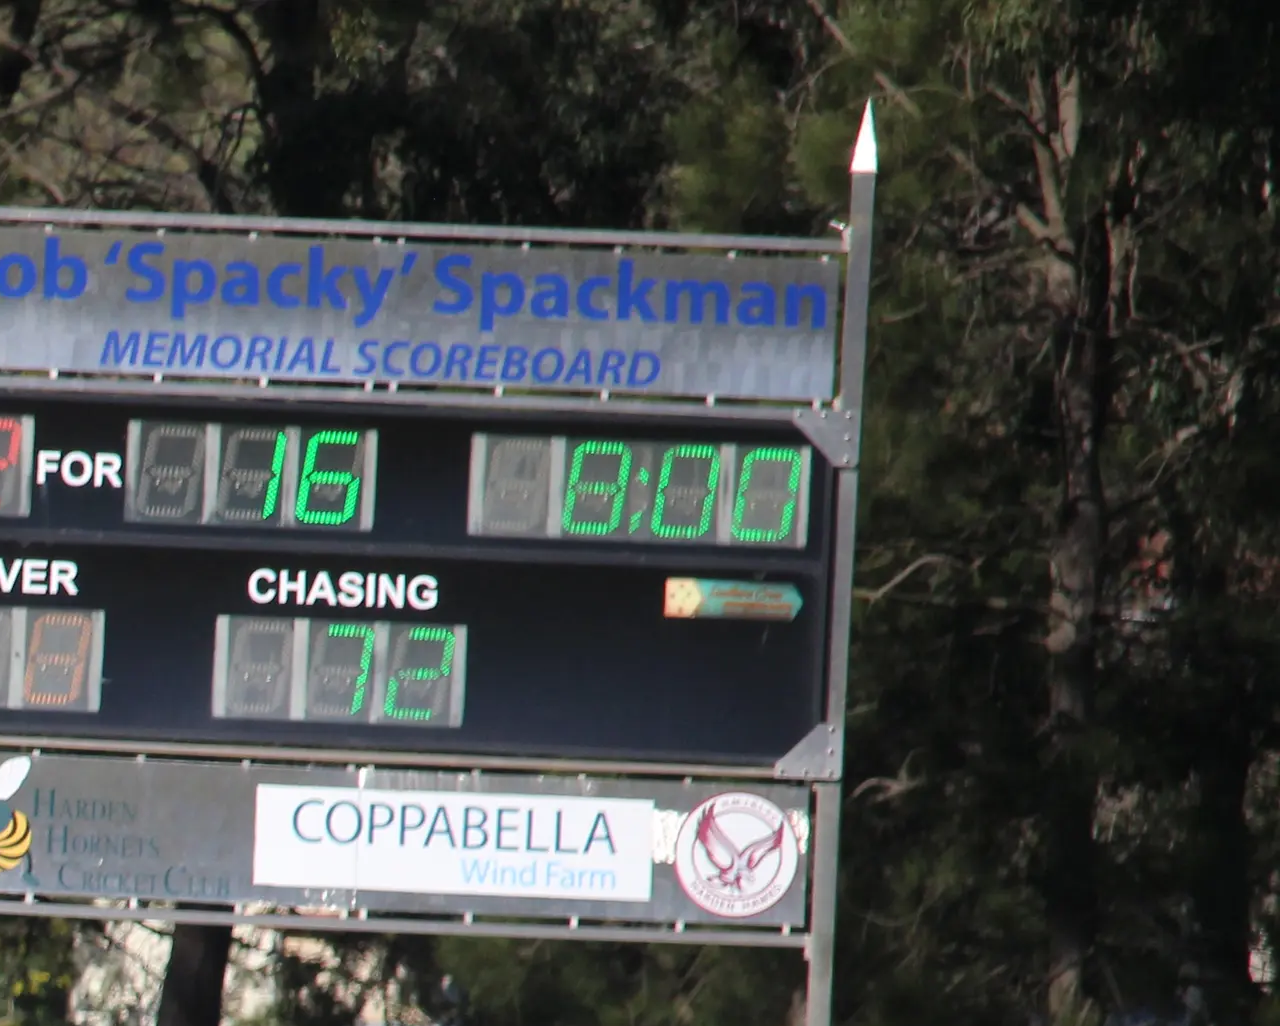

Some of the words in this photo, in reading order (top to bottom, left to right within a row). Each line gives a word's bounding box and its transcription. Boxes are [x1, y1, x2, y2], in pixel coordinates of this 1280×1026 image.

[432, 254, 827, 334] Spackman
[98, 329, 340, 377] MEMORIAL
[354, 338, 662, 388] SCOREBOARD
[36, 450, 122, 488] FOR
[260, 429, 362, 526] 16
[560, 439, 803, 542] 8:00
[248, 568, 438, 610] CHASING
[327, 623, 457, 721] 72
[292, 799, 617, 855] COPPABELLA
[460, 859, 538, 887] Wind
[544, 863, 617, 891] Farm
